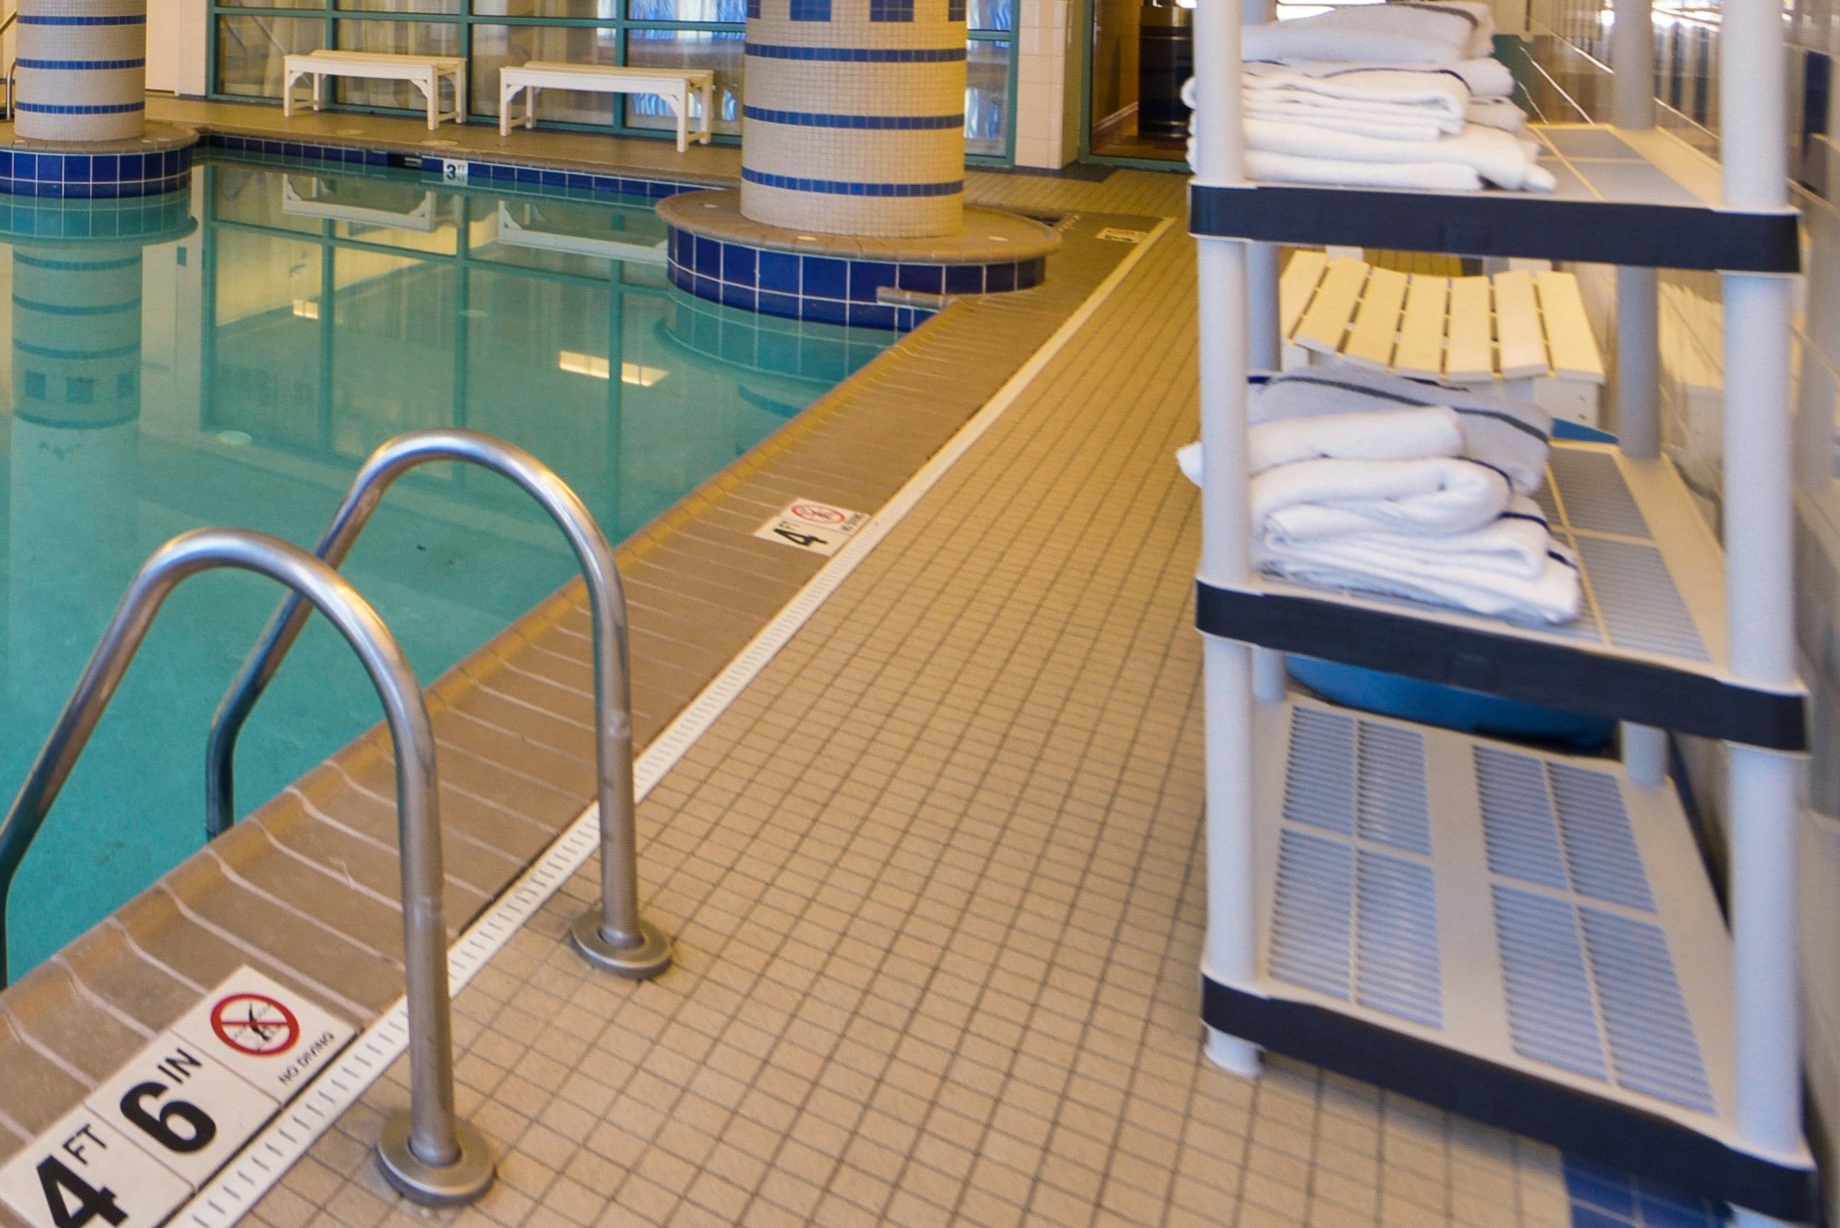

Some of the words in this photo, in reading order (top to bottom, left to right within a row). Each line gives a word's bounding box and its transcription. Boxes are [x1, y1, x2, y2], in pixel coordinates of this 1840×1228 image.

[157, 1048, 202, 1084] IN
[278, 1065, 299, 1086] NO
[297, 1032, 334, 1068] DIVING
[62, 1122, 107, 1165] FT
[120, 1081, 217, 1154] 6
[36, 1155, 128, 1228] 4
